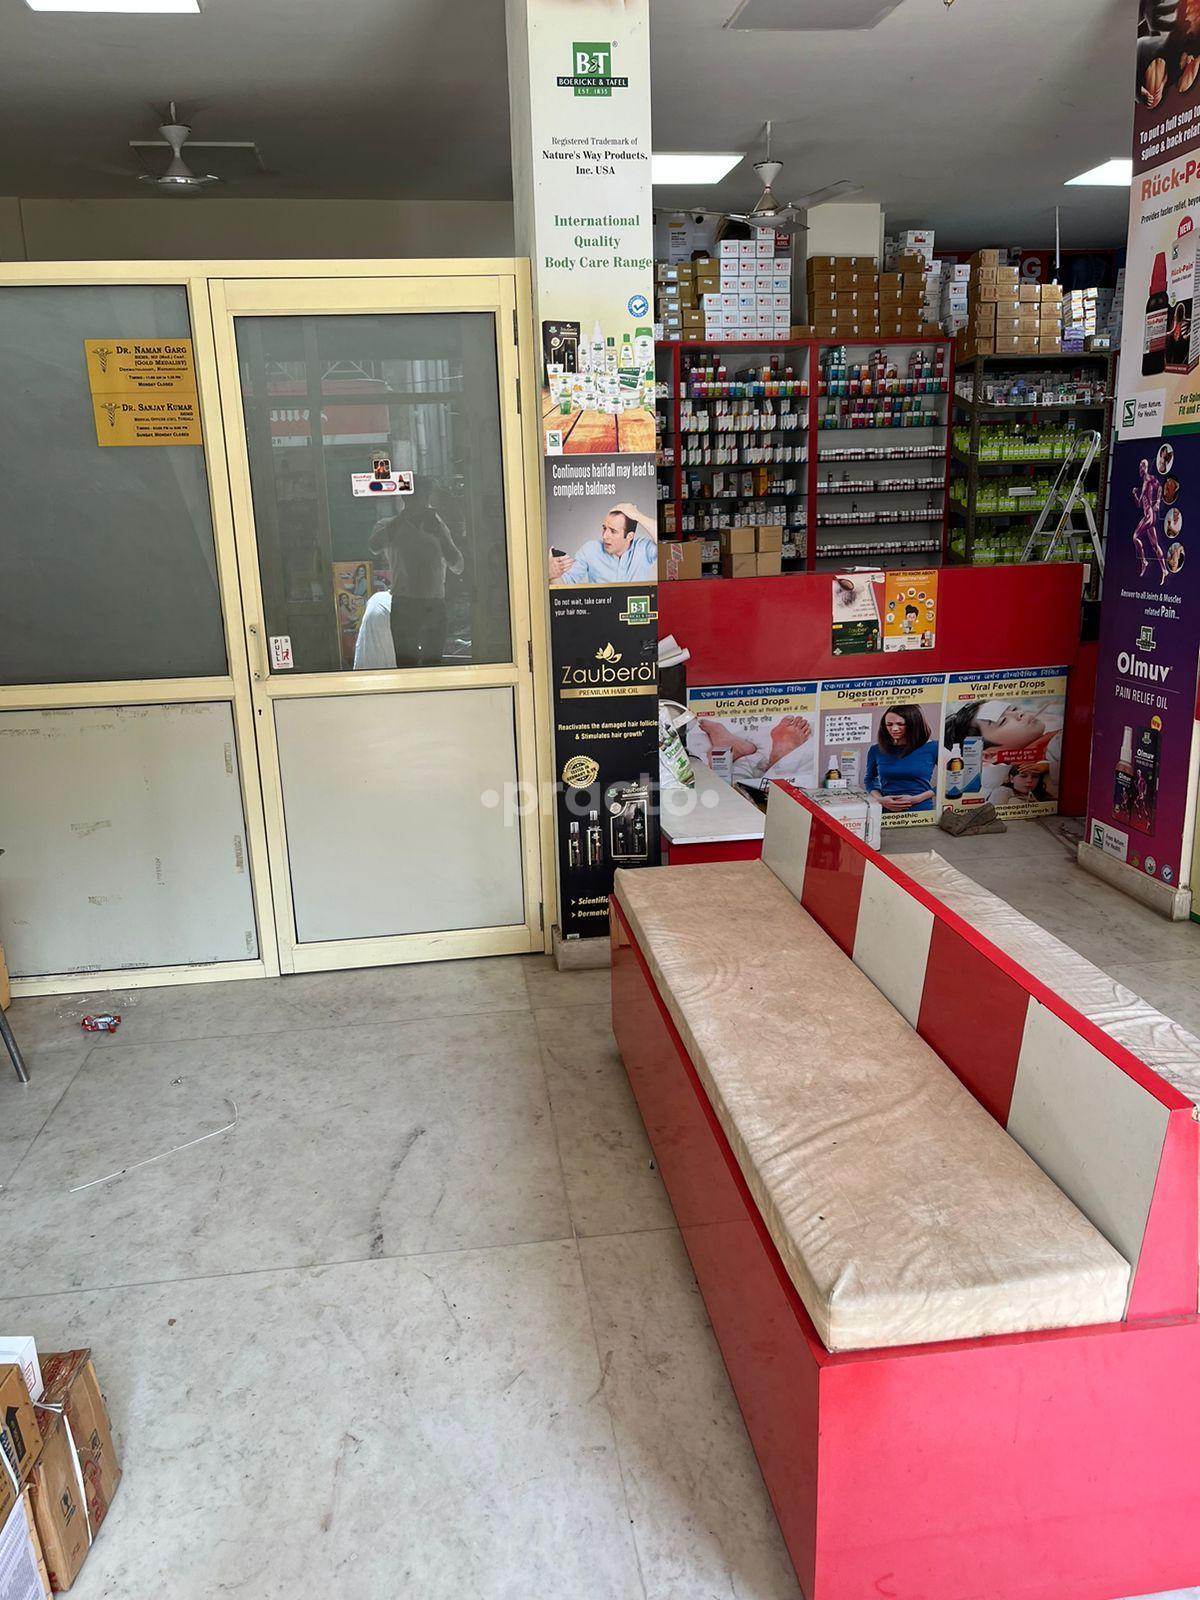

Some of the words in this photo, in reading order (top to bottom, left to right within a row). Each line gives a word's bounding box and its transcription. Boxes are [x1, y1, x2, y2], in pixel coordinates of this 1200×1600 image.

[558, 78, 597, 86] BOERICKE
[606, 78, 627, 86] TAFEL
[1140, 132, 1147, 144] To
[1149, 124, 1159, 140] put
[1160, 123, 1164, 135] a
[1166, 117, 1176, 132] full
[1178, 111, 1192, 128] stop
[552, 137, 589, 146] Registered
[590, 137, 629, 145] Trademark
[630, 137, 637, 145] of
[1141, 143, 1159, 161] spine
[1160, 141, 1165, 152] &
[1166, 130, 1182, 149] back
[542, 150, 581, 160] Nature's
[583, 151, 602, 162] Way
[604, 151, 648, 162] Products,
[576, 166, 593, 175] Inc.
[595, 166, 615, 175] USA
[1141, 211, 1159, 224] Provides
[1160, 204, 1173, 218] faster
[1174, 199, 1186, 212] relief,
[554, 215, 640, 226] International
[1179, 221, 1192, 236] NEW
[574, 235, 620, 249] Quality
[545, 256, 576, 270] Body
[579, 257, 610, 268] Care
[613, 257, 653, 270] Range
[1138, 402, 1148, 410] From
[553, 464, 590, 479] Continuous
[592, 463, 615, 478] hairfall
[617, 465, 630, 478] may
[632, 463, 647, 477] lead
[648, 462, 654, 476] to
[554, 482, 584, 498] complete
[586, 482, 616, 495] baldness
[571, 598, 583, 606] wait,
[607, 596, 612, 604] of
[1121, 589, 1135, 598] Answer
[1146, 592, 1158, 601] Joints
[1159, 593, 1163, 601] &
[1164, 594, 1181, 603] Muscles
[555, 609, 565, 617] your
[1144, 608, 1160, 617] related
[561, 662, 656, 684] Zauberöl
[1117, 652, 1169, 683] Olmuv
[971, 683, 990, 691] Viral
[1020, 680, 1045, 688] Drops
[838, 689, 888, 699] Digestion
[892, 687, 923, 695] Drops
[1115, 685, 1131, 700] PAIN
[1132, 687, 1154, 706] RELIEF
[1156, 695, 1168, 710] OIL
[737, 699, 758, 707] Acid
[762, 698, 790, 706] Drops
[558, 723, 590, 731] Reactivates
[601, 722, 626, 731] damaged
[889, 819, 908, 827] really
